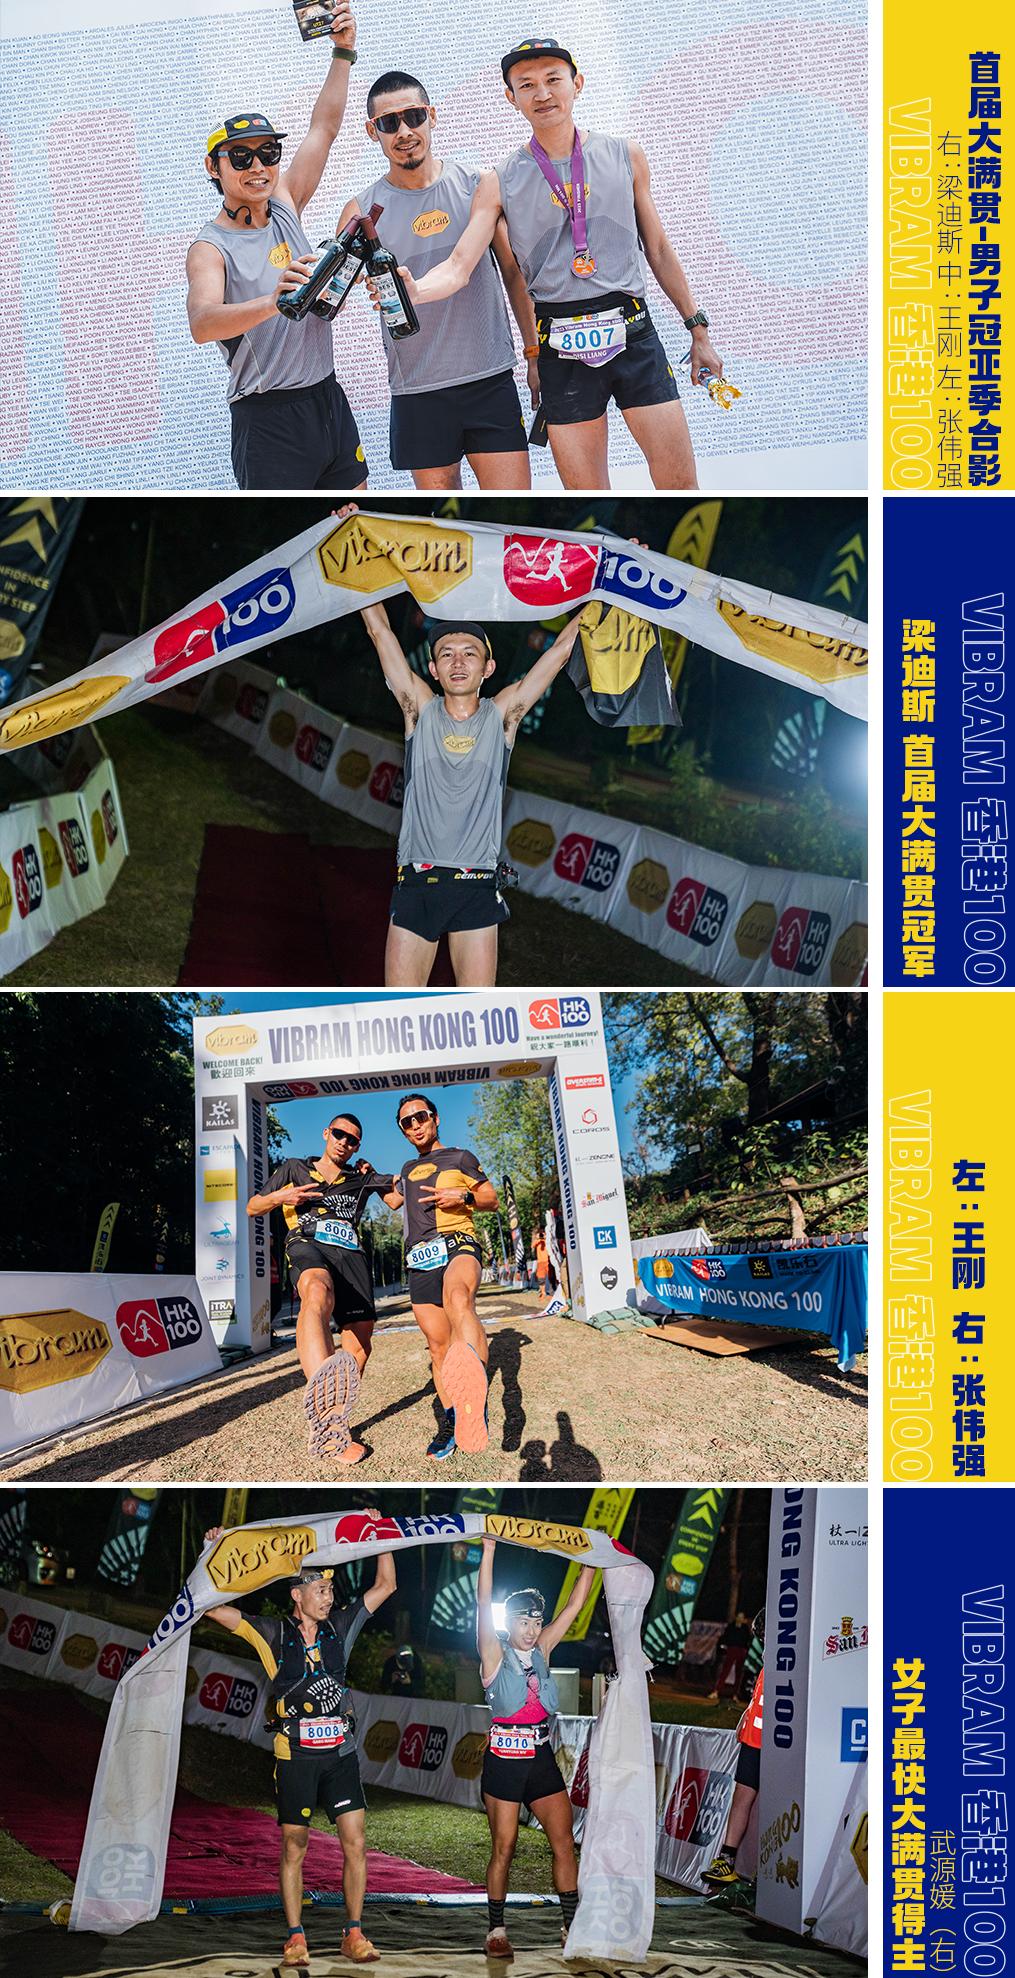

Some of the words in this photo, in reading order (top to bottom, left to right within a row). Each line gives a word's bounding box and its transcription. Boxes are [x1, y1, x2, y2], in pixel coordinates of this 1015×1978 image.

[561, 328, 616, 350] 8007
[587, 350, 607, 359] LIANG
[322, 525, 467, 574] vibram
[4, 580, 17, 593] IN
[604, 556, 684, 601] 100
[10, 596, 37, 613] STEP
[222, 578, 293, 634] 100
[594, 848, 618, 867] HK
[585, 867, 614, 887] 100
[703, 896, 727, 922] HK
[694, 917, 721, 940] 100
[807, 921, 831, 945] HK
[799, 942, 823, 966] 100
[562, 999, 587, 1012] HK
[561, 1010, 590, 1024] 100
[208, 1031, 258, 1049] vibram
[268, 1021, 352, 1065] VIBRAM
[356, 1014, 416, 1057] HONG
[419, 1009, 477, 1051] KONG
[480, 1006, 520, 1045] 100
[203, 1057, 240, 1070] WELCOME
[240, 1056, 263, 1066] BACK!
[210, 1066, 256, 1080] 歡迎回來
[391, 1072, 432, 1088] HONG
[434, 1065, 490, 1085] VIBRAM
[318, 1080, 348, 1094] 100
[348, 1076, 390, 1091] KONG
[206, 1119, 235, 1127] KAILAS
[251, 1098, 263, 1159] VIBRAM
[572, 1126, 610, 1134] COROS
[549, 1073, 562, 1131] VIBRAM
[557, 1134, 568, 1175] HONG
[563, 1178, 573, 1220] KONG
[568, 1222, 577, 1250] 100
[581, 1199, 595, 1209] San
[254, 1215, 265, 1246] ONG
[324, 1222, 354, 1241] 8008
[597, 1230, 612, 1242] CK
[255, 1250, 265, 1278] 100
[411, 1246, 439, 1263] 8009
[708, 1260, 722, 1270] HK
[709, 1268, 726, 1278] 100
[656, 1283, 694, 1301] VIBRAM
[699, 1287, 737, 1306] HONG
[740, 1290, 788, 1310] KONG
[791, 1291, 823, 1313] 100
[164, 1302, 192, 1322] HK
[166, 1319, 200, 1341] 100
[490, 1518, 589, 1548] vibram
[212, 1532, 314, 1584] vibram
[148, 1597, 192, 1649] 100
[776, 1568, 800, 1672] KONG
[36, 1626, 54, 1638] HK
[31, 1636, 52, 1651] 100
[825, 1634, 859, 1657] San
[234, 1684, 256, 1700] HK
[228, 1697, 252, 1713] 100
[773, 1679, 795, 1749] 100
[308, 1725, 340, 1738] 8008
[428, 1733, 445, 1749] HK
[423, 1748, 443, 1764] 100
[704, 1782, 729, 1809] HK
[695, 1808, 722, 1835] 100
